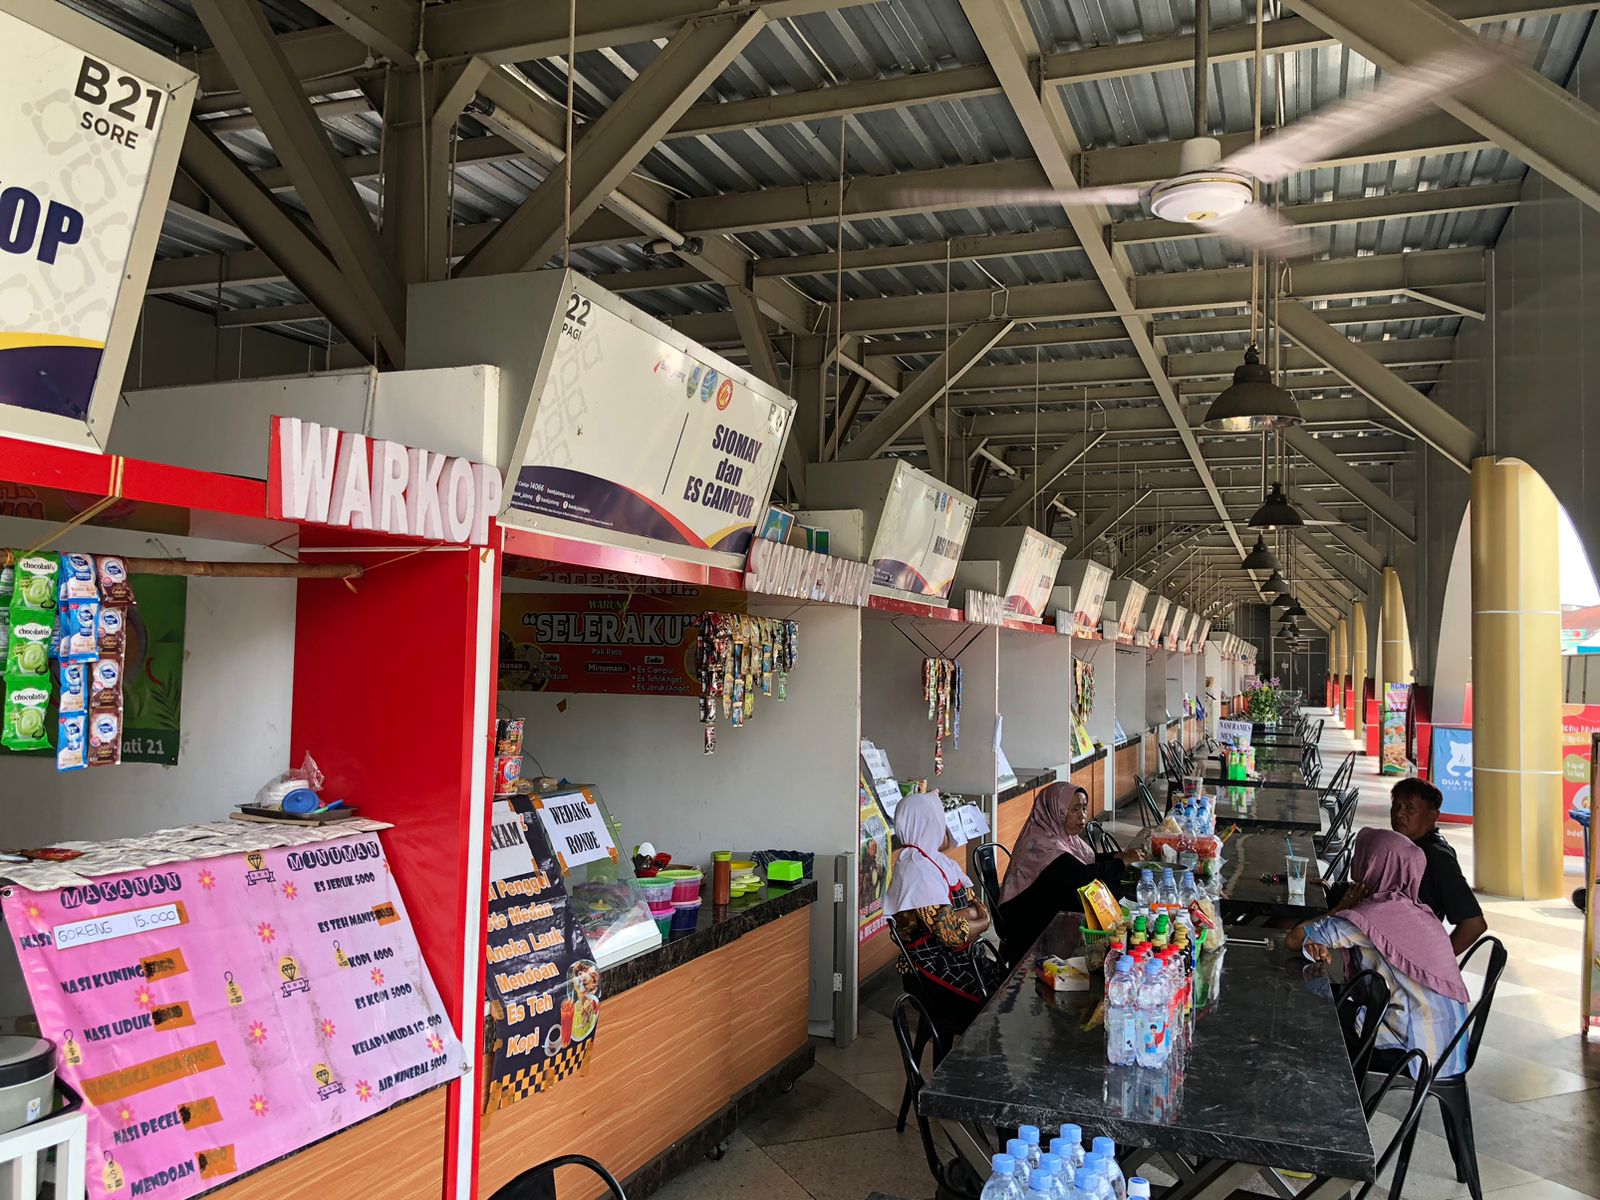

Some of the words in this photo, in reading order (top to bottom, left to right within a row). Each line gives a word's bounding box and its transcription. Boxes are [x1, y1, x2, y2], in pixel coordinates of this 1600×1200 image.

[74, 56, 163, 130] B21
[80, 112, 139, 149] SORE
[561, 323, 582, 341] PAGI
[712, 424, 762, 464] SIOMAY
[278, 417, 500, 545] WARKOP
[529, 481, 545, 493] 14066
[715, 458, 743, 487] dan
[683, 475, 702, 503] ES
[701, 482, 755, 519] CAMPUR
[589, 600, 631, 610] WARUNG
[147, 739, 165, 754] 21
[549, 801, 592, 825] WEDANG
[287, 841, 380, 872] MINUMAN
[565, 831, 600, 855] RONDE
[61, 872, 182, 909] MAKANAN
[314, 881, 326, 893] ES
[326, 875, 354, 890] JERUK
[355, 872, 375, 885] 5000
[58, 921, 112, 942] GORENG
[134, 910, 176, 928] 15.000
[318, 921, 330, 933] ES
[330, 916, 350, 930] TEH
[350, 911, 375, 927] MANIS
[508, 902, 554, 926] Medan
[348, 953, 372, 968] KOPI
[374, 947, 394, 961] 4000
[486, 938, 531, 964] Aneka
[528, 926, 565, 951] Lauk
[61, 976, 92, 994] NASI
[93, 964, 145, 988] KUNING
[495, 962, 560, 994] Mendoan
[354, 997, 366, 1010] ES
[366, 990, 389, 1006] KOPI
[391, 983, 412, 999] 5000
[506, 1002, 525, 1025] Es
[527, 992, 553, 1017] Teh
[84, 1024, 111, 1042] NASI
[112, 1013, 152, 1035] UDUK
[352, 1034, 388, 1056] KELAPA
[387, 1025, 414, 1042] MUDA
[506, 1026, 540, 1058] Kopi
[378, 1076, 394, 1092] AIR
[393, 1061, 429, 1083] MINERAL
[431, 1053, 447, 1071] 5000
[114, 1126, 141, 1145] NASI
[142, 1110, 182, 1137] PECEL
[131, 1160, 195, 1197] MENDOAN
